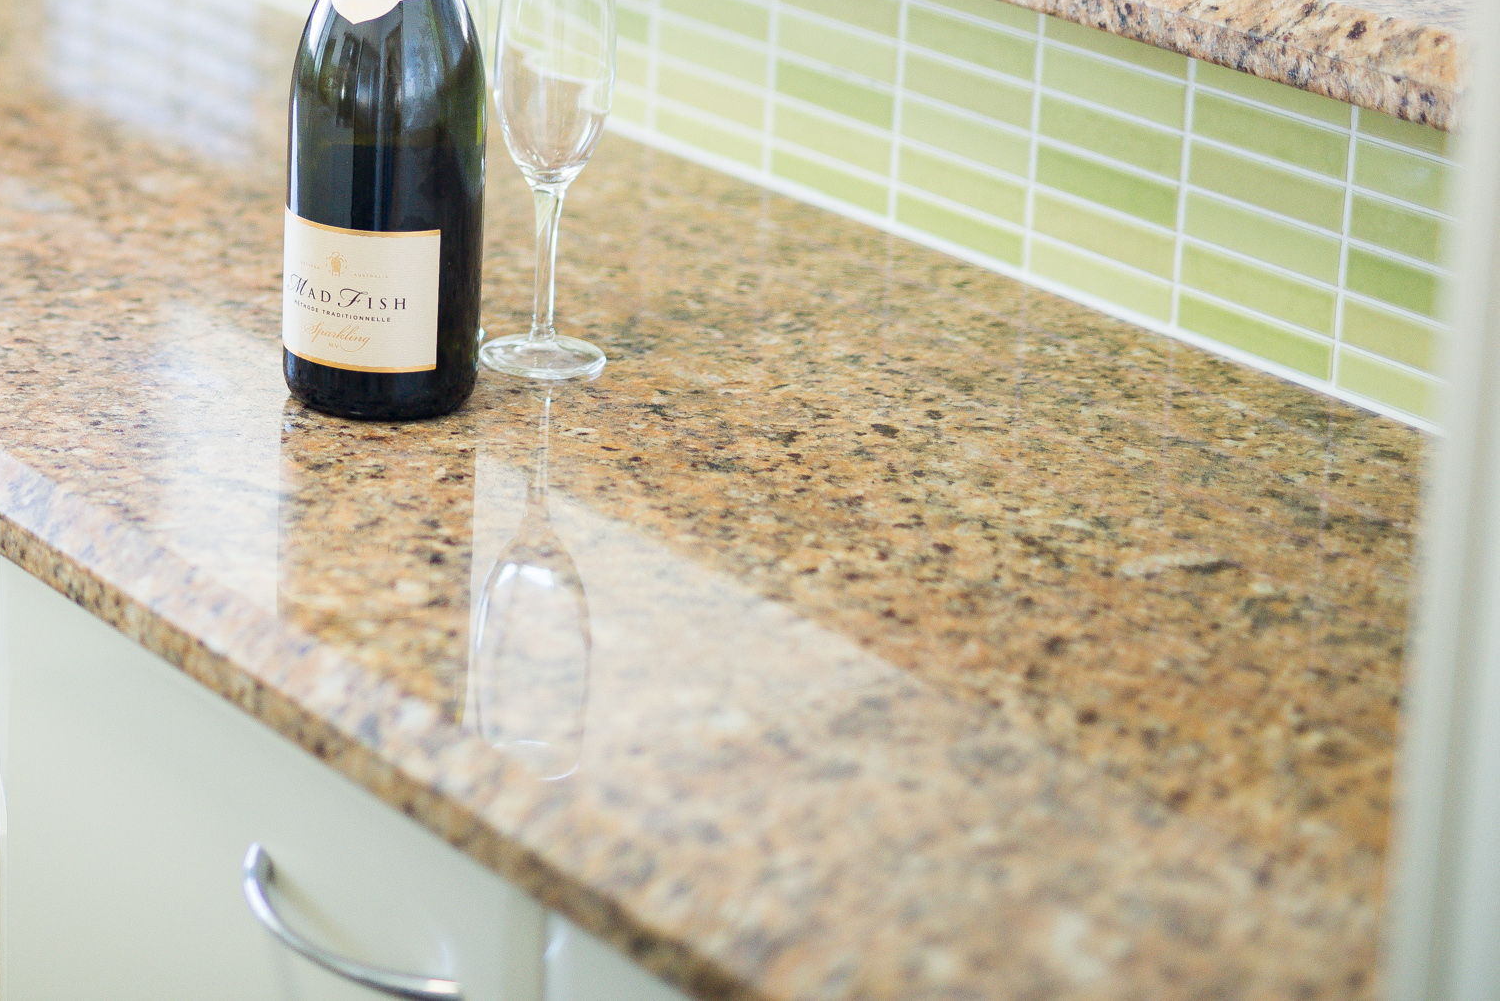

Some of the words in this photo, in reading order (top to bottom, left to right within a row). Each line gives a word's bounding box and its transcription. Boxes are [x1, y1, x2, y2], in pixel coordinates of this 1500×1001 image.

[287, 274, 332, 303] MAD
[337, 288, 407, 310] FISH
[322, 309, 392, 323] TRADITIONNELLE
[303, 321, 371, 352] Sparkling
